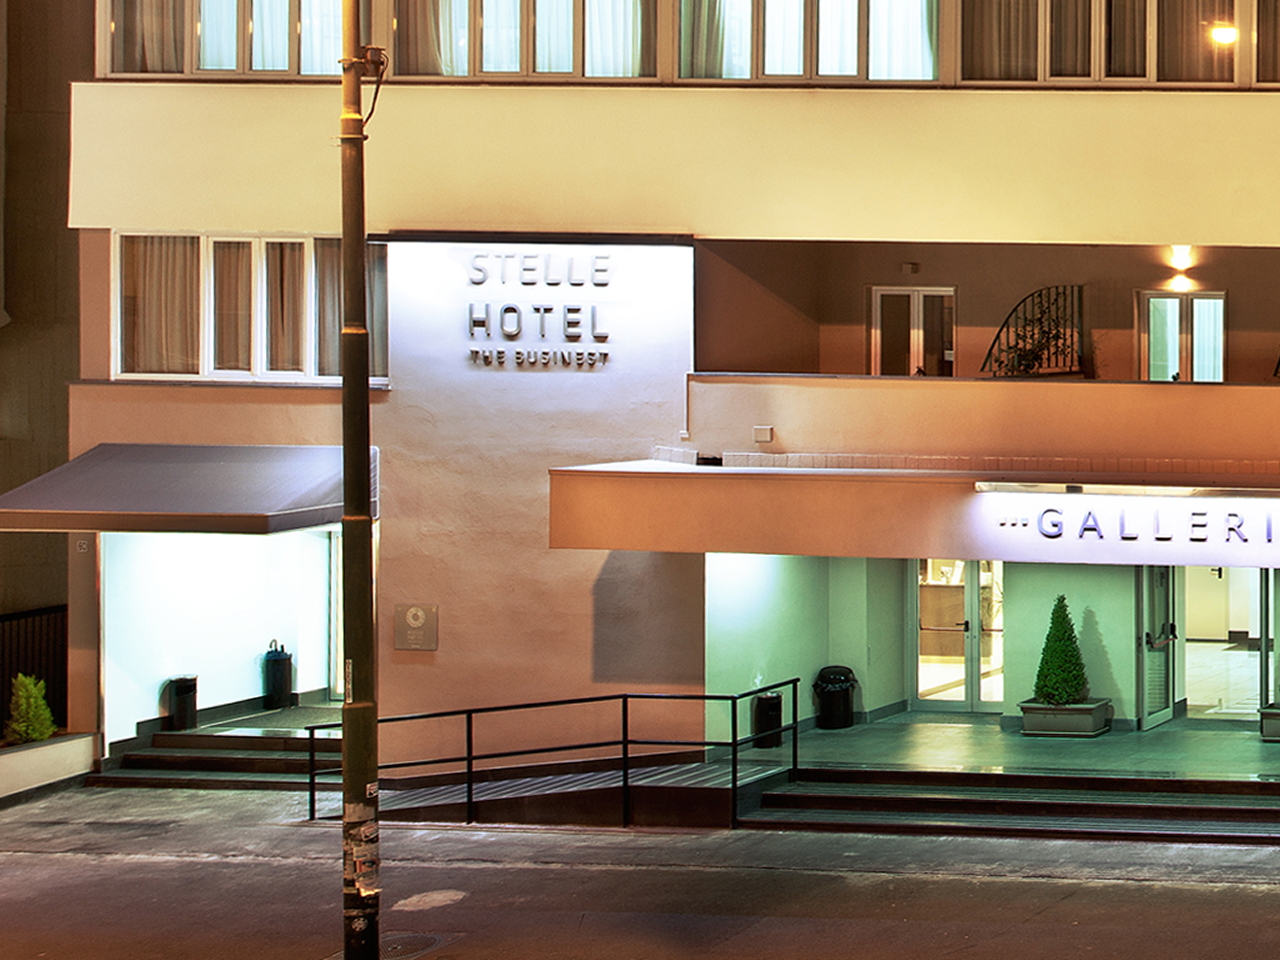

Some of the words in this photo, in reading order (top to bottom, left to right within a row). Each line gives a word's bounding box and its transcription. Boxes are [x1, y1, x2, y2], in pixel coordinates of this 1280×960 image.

[469, 253, 609, 286] STELLE
[468, 302, 610, 343] HOTEL
[469, 348, 506, 367] THE
[514, 349, 610, 368] BUSINEST
